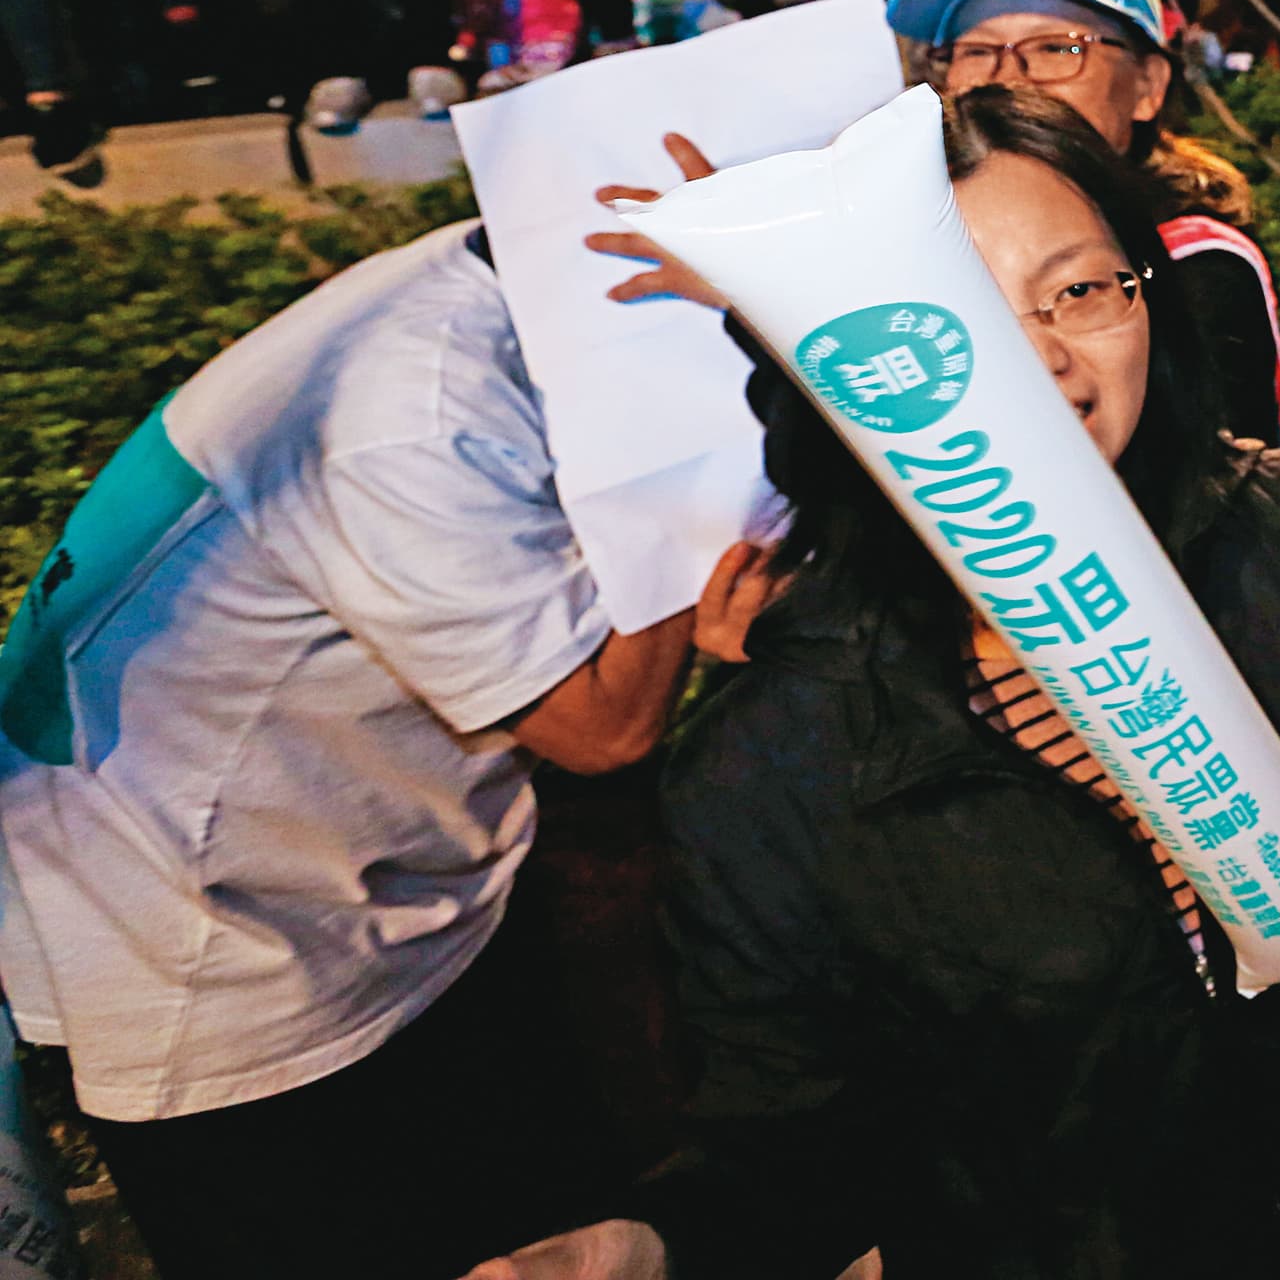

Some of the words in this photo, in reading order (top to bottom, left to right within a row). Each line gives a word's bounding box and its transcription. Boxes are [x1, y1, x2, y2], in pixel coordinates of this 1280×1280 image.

[835, 344, 930, 403] 眾
[1069, 636, 1262, 852] 台灣民眾黨
